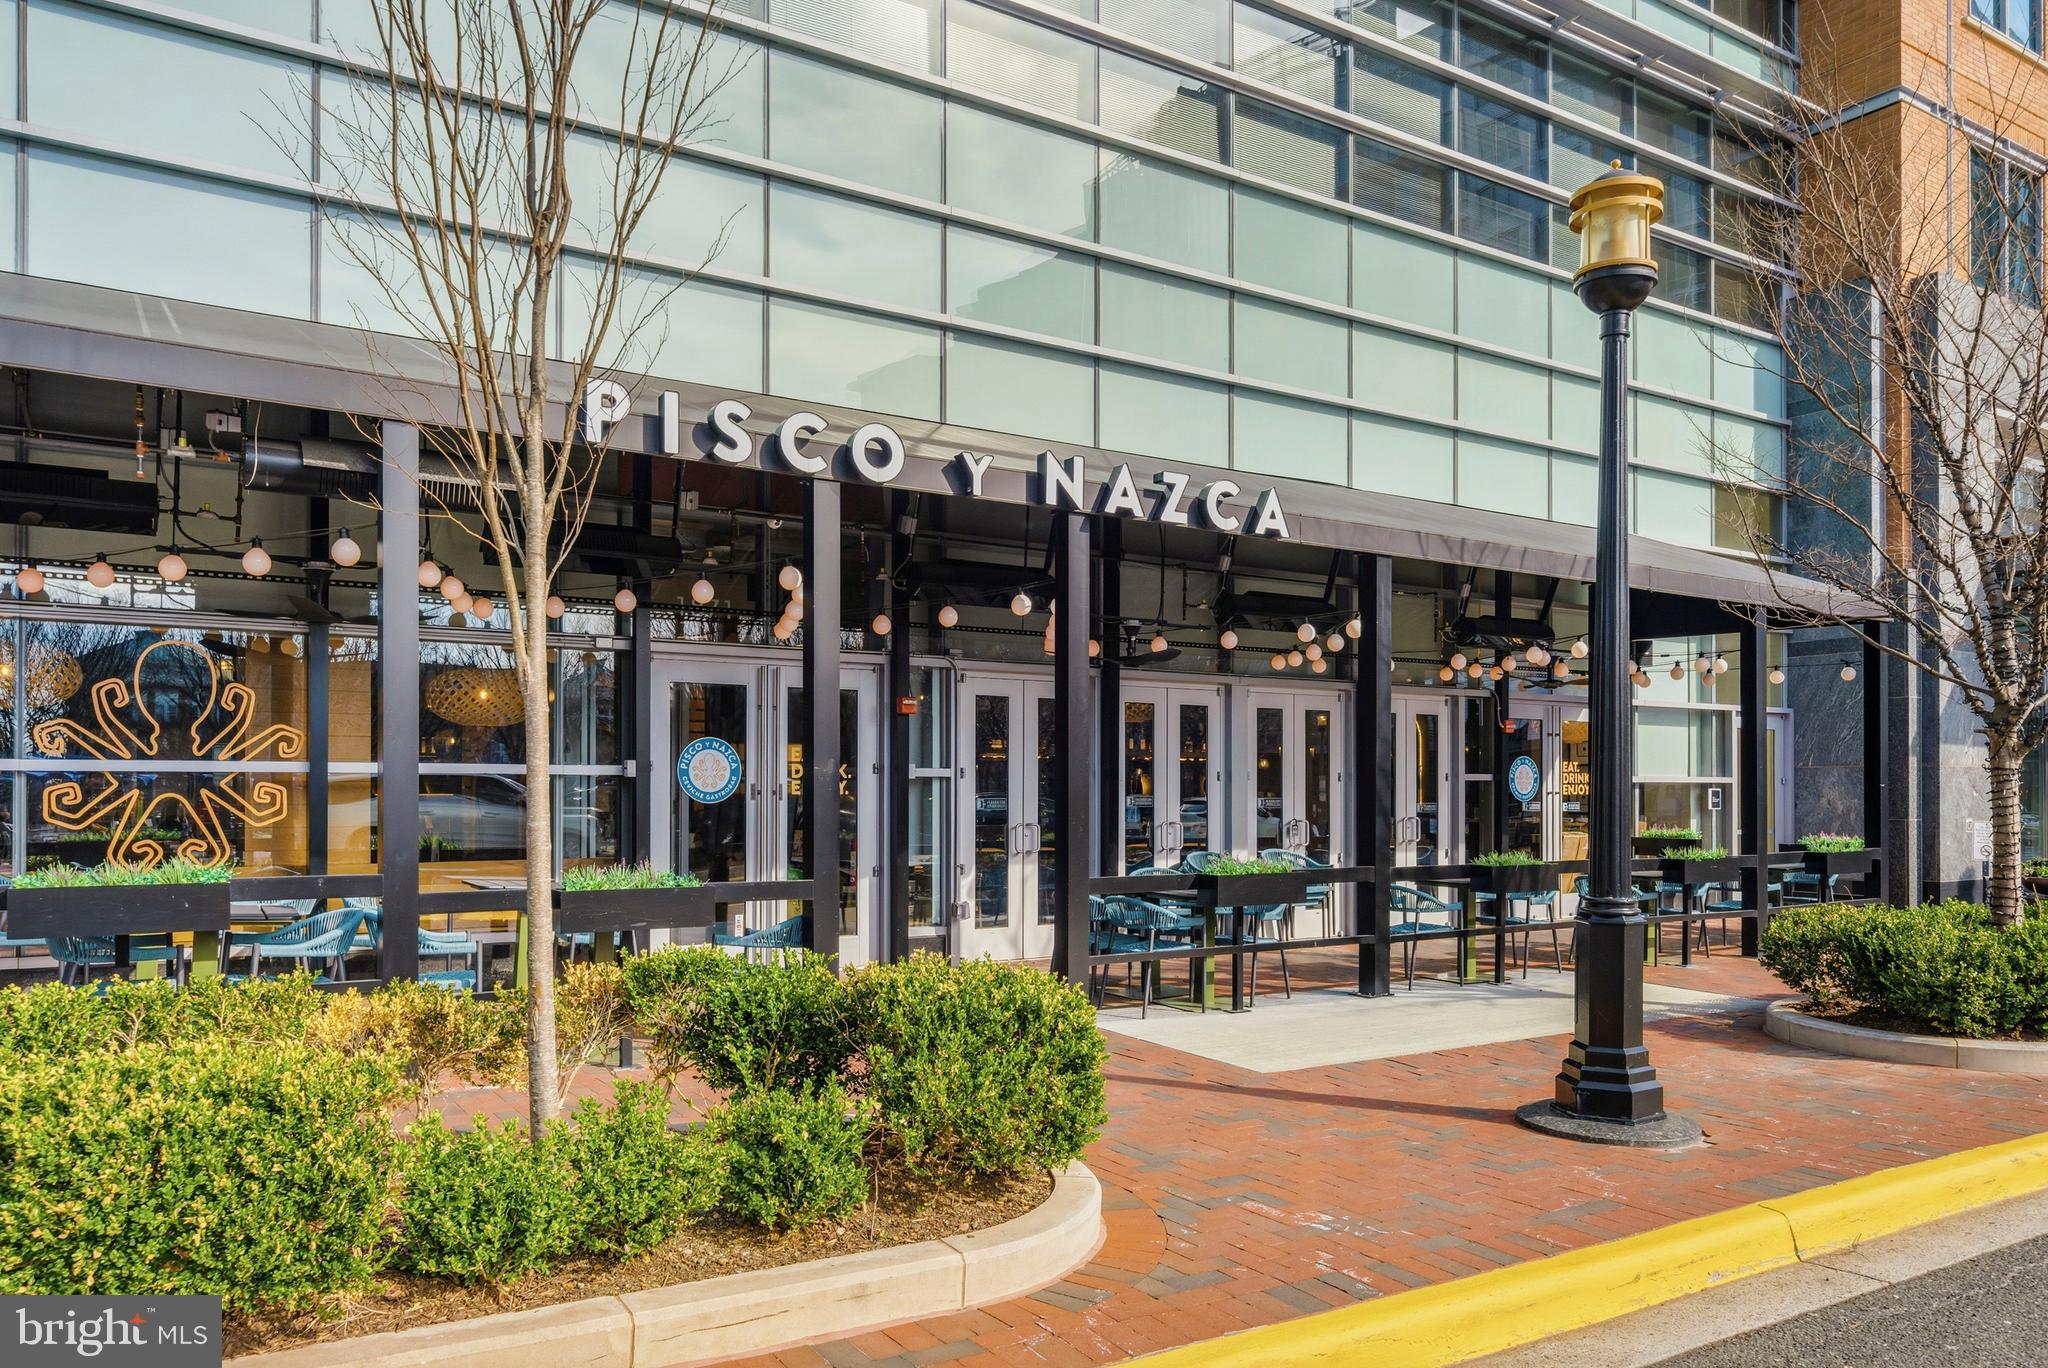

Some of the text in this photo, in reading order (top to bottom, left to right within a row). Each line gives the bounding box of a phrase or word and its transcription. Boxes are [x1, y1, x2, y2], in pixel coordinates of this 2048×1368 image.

[586, 377, 1291, 539] PISCO Y NAZCA
[680, 743, 703, 769] PISCO
[712, 741, 738, 769] NAZCA
